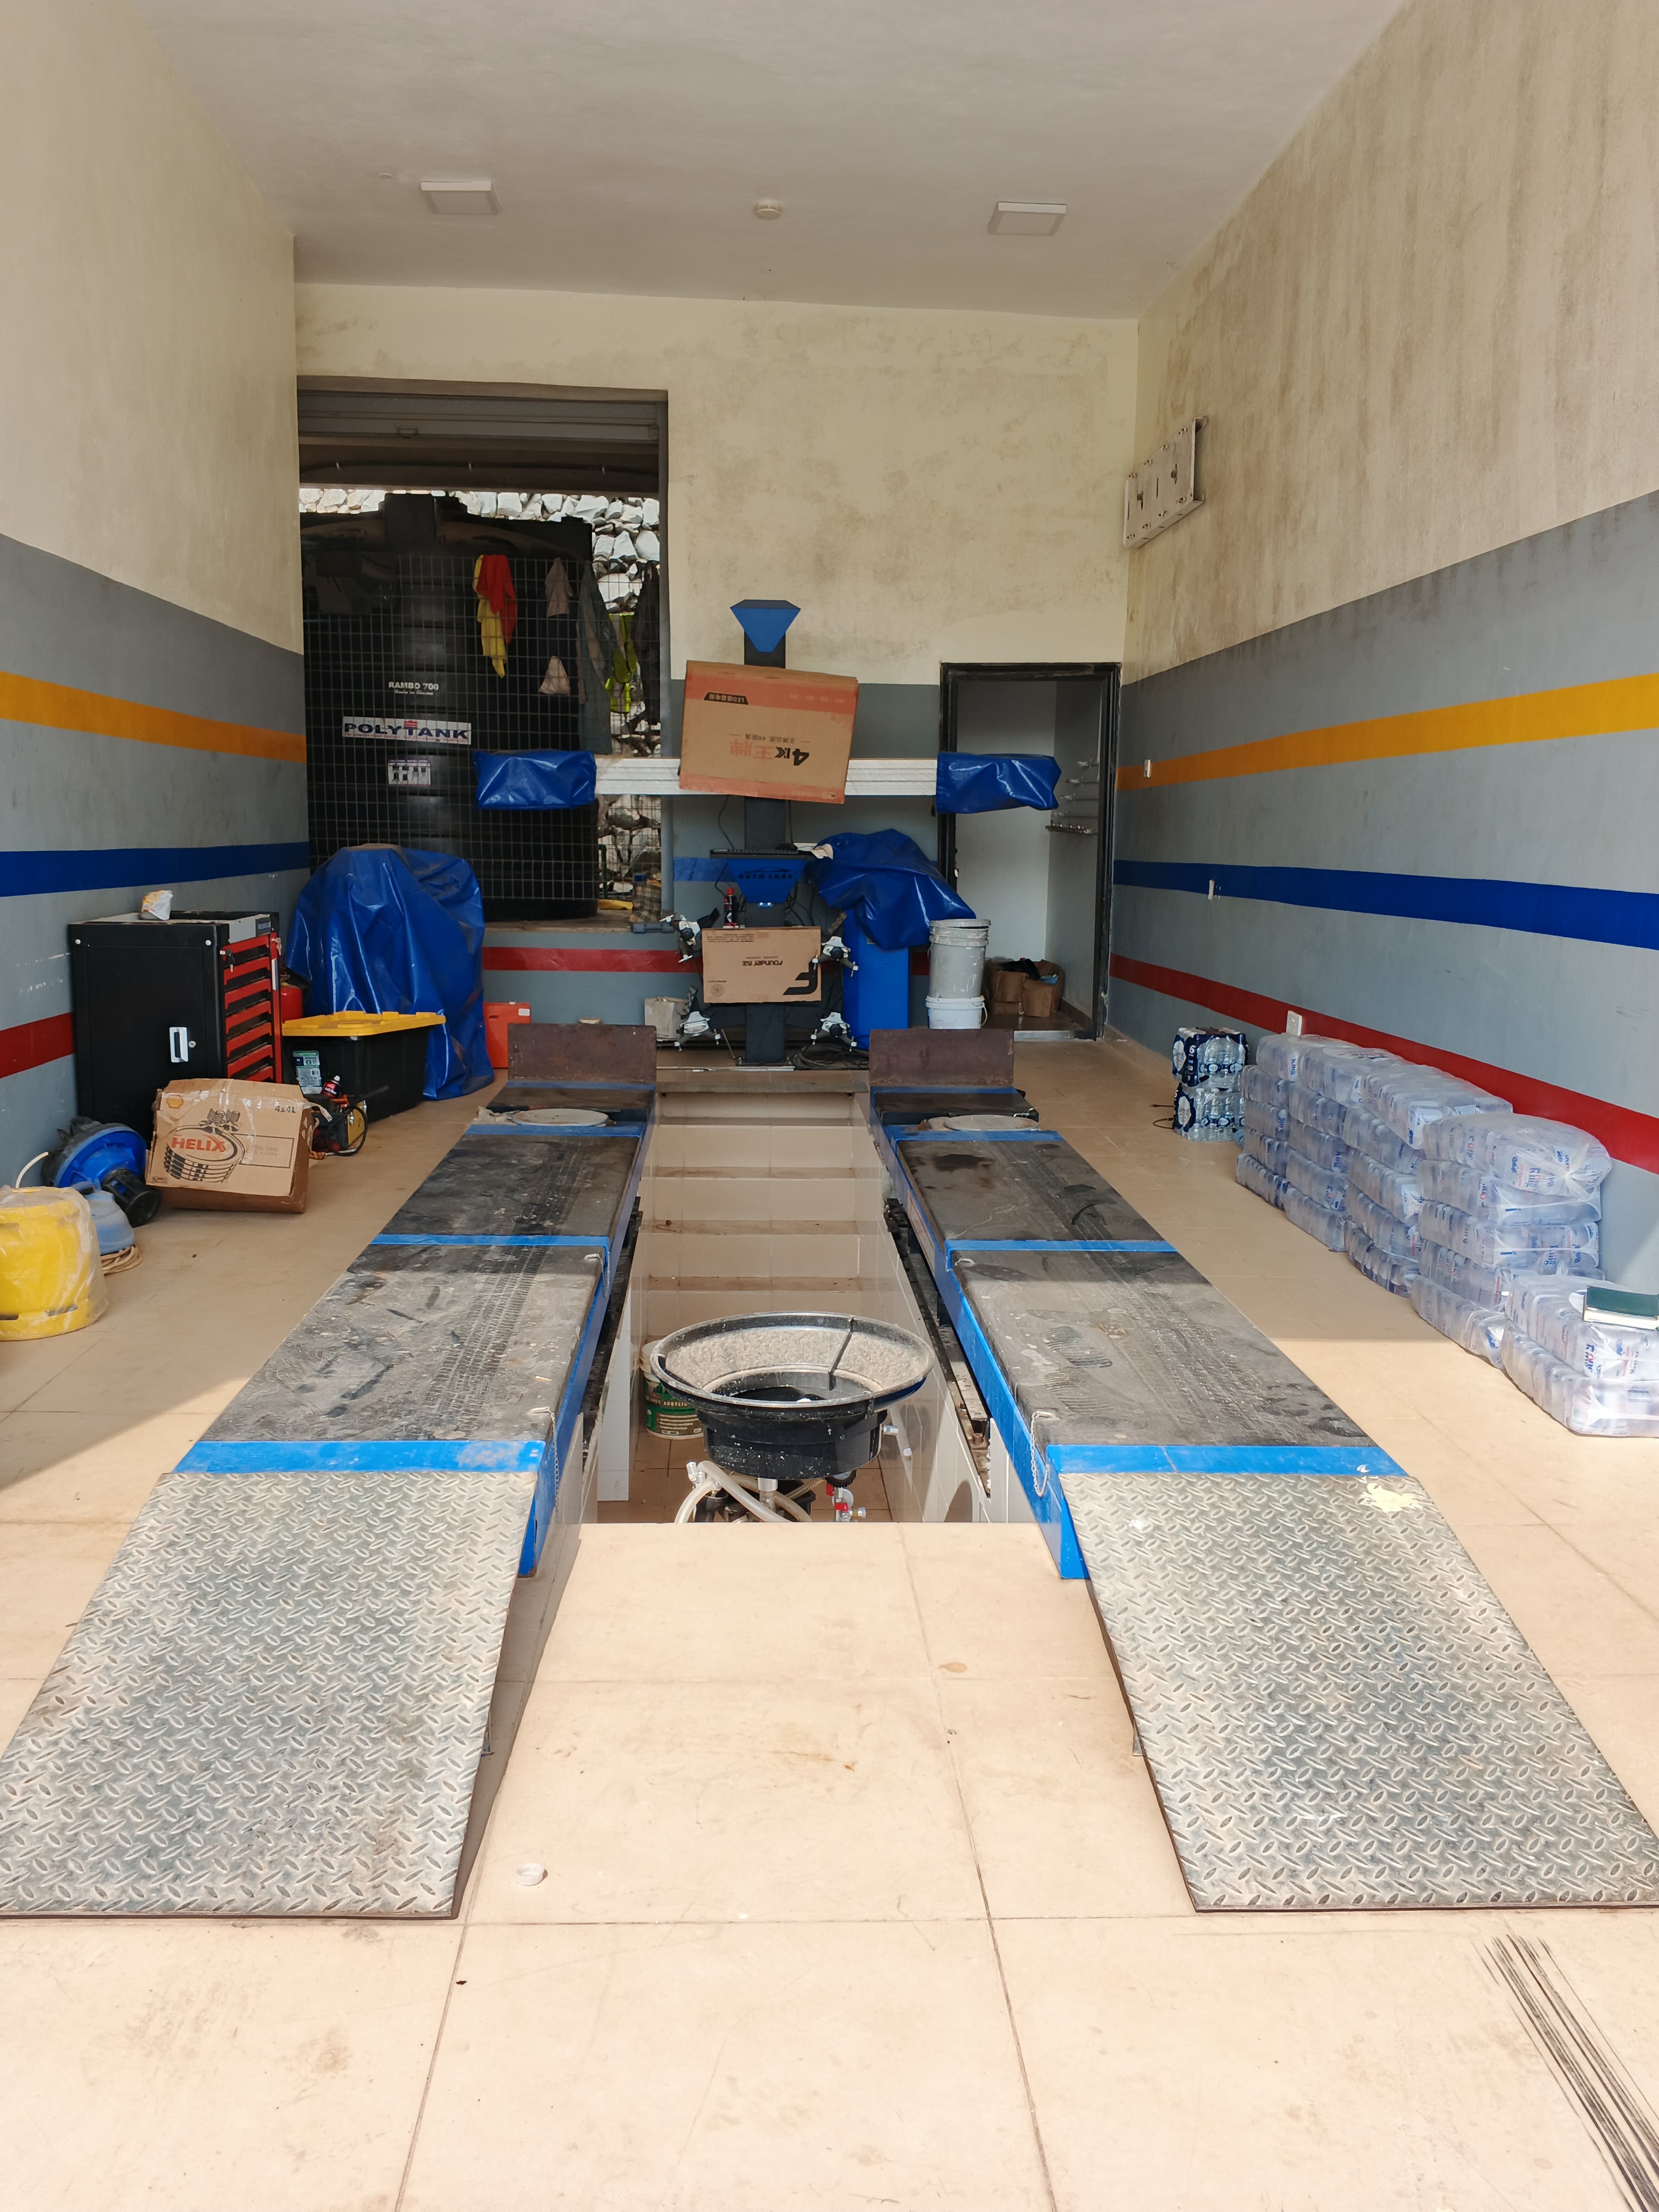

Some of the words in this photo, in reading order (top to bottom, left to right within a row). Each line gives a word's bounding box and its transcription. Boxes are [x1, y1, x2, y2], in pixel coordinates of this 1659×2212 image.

[344, 723, 468, 739] POLYTANK
[275, 1105, 296, 1113] 4x4L
[172, 1135, 226, 1152] HELIX
